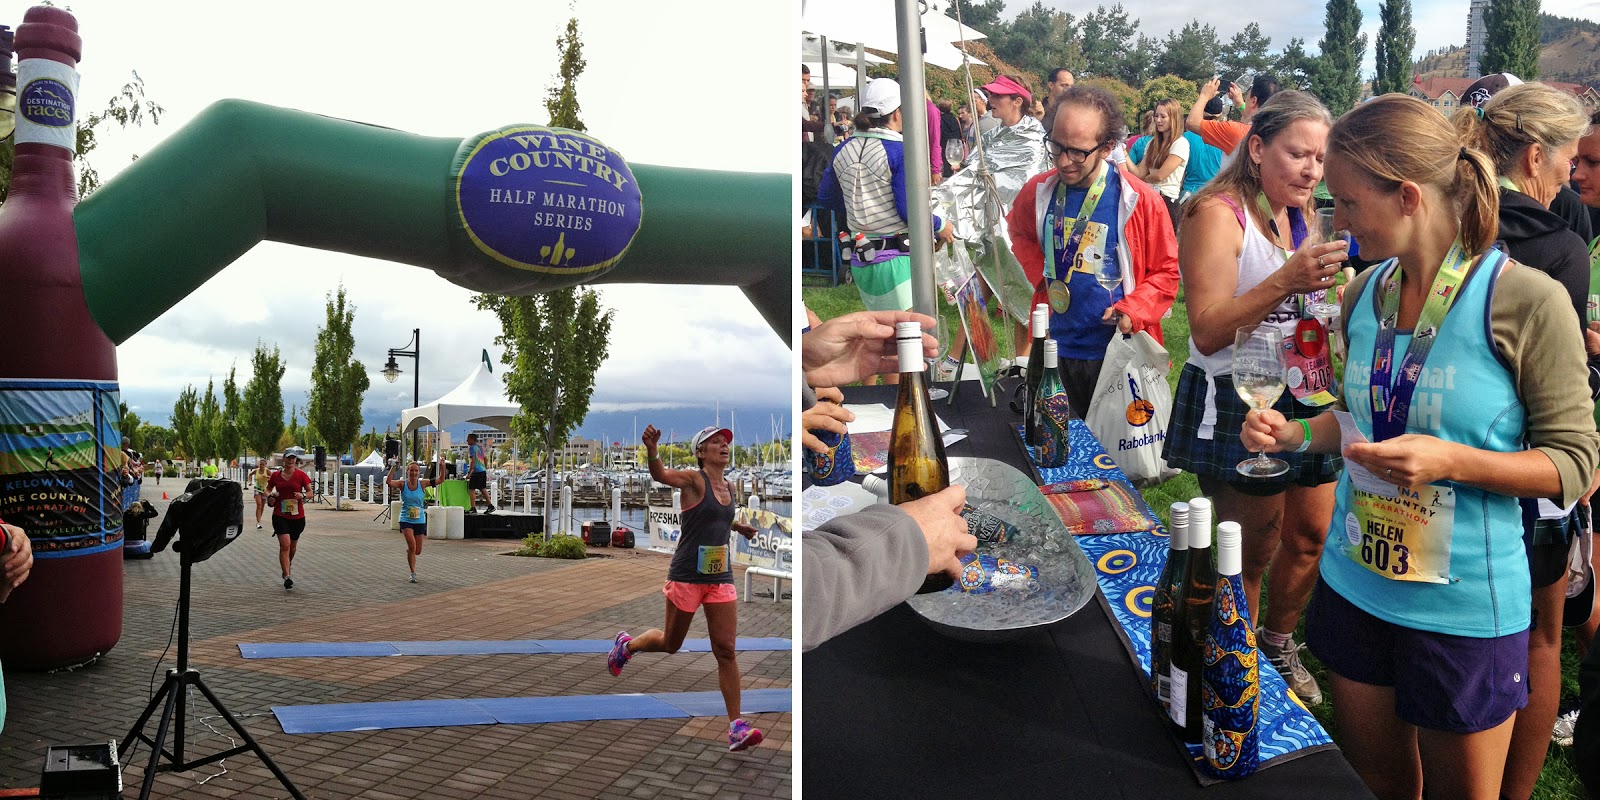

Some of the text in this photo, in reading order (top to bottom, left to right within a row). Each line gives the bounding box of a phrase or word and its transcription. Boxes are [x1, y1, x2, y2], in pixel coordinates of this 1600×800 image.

[26, 98, 71, 110] DESTINATION
[27, 105, 71, 121] races
[509, 134, 607, 161] WINE
[489, 151, 629, 192] COUNTRY
[489, 188, 626, 218] HALF MARATHON
[533, 211, 593, 231] SERIES
[1118, 429, 1167, 451] Rabobank
[5, 478, 75, 491] KELOWNA
[30, 492, 91, 504] COUNTRY
[0, 503, 87, 517] ALF MARATHON
[1373, 501, 1429, 526] MARATHON
[1367, 519, 1404, 543] HELEN
[1361, 533, 1409, 576] 603
[707, 562, 724, 573] 392
